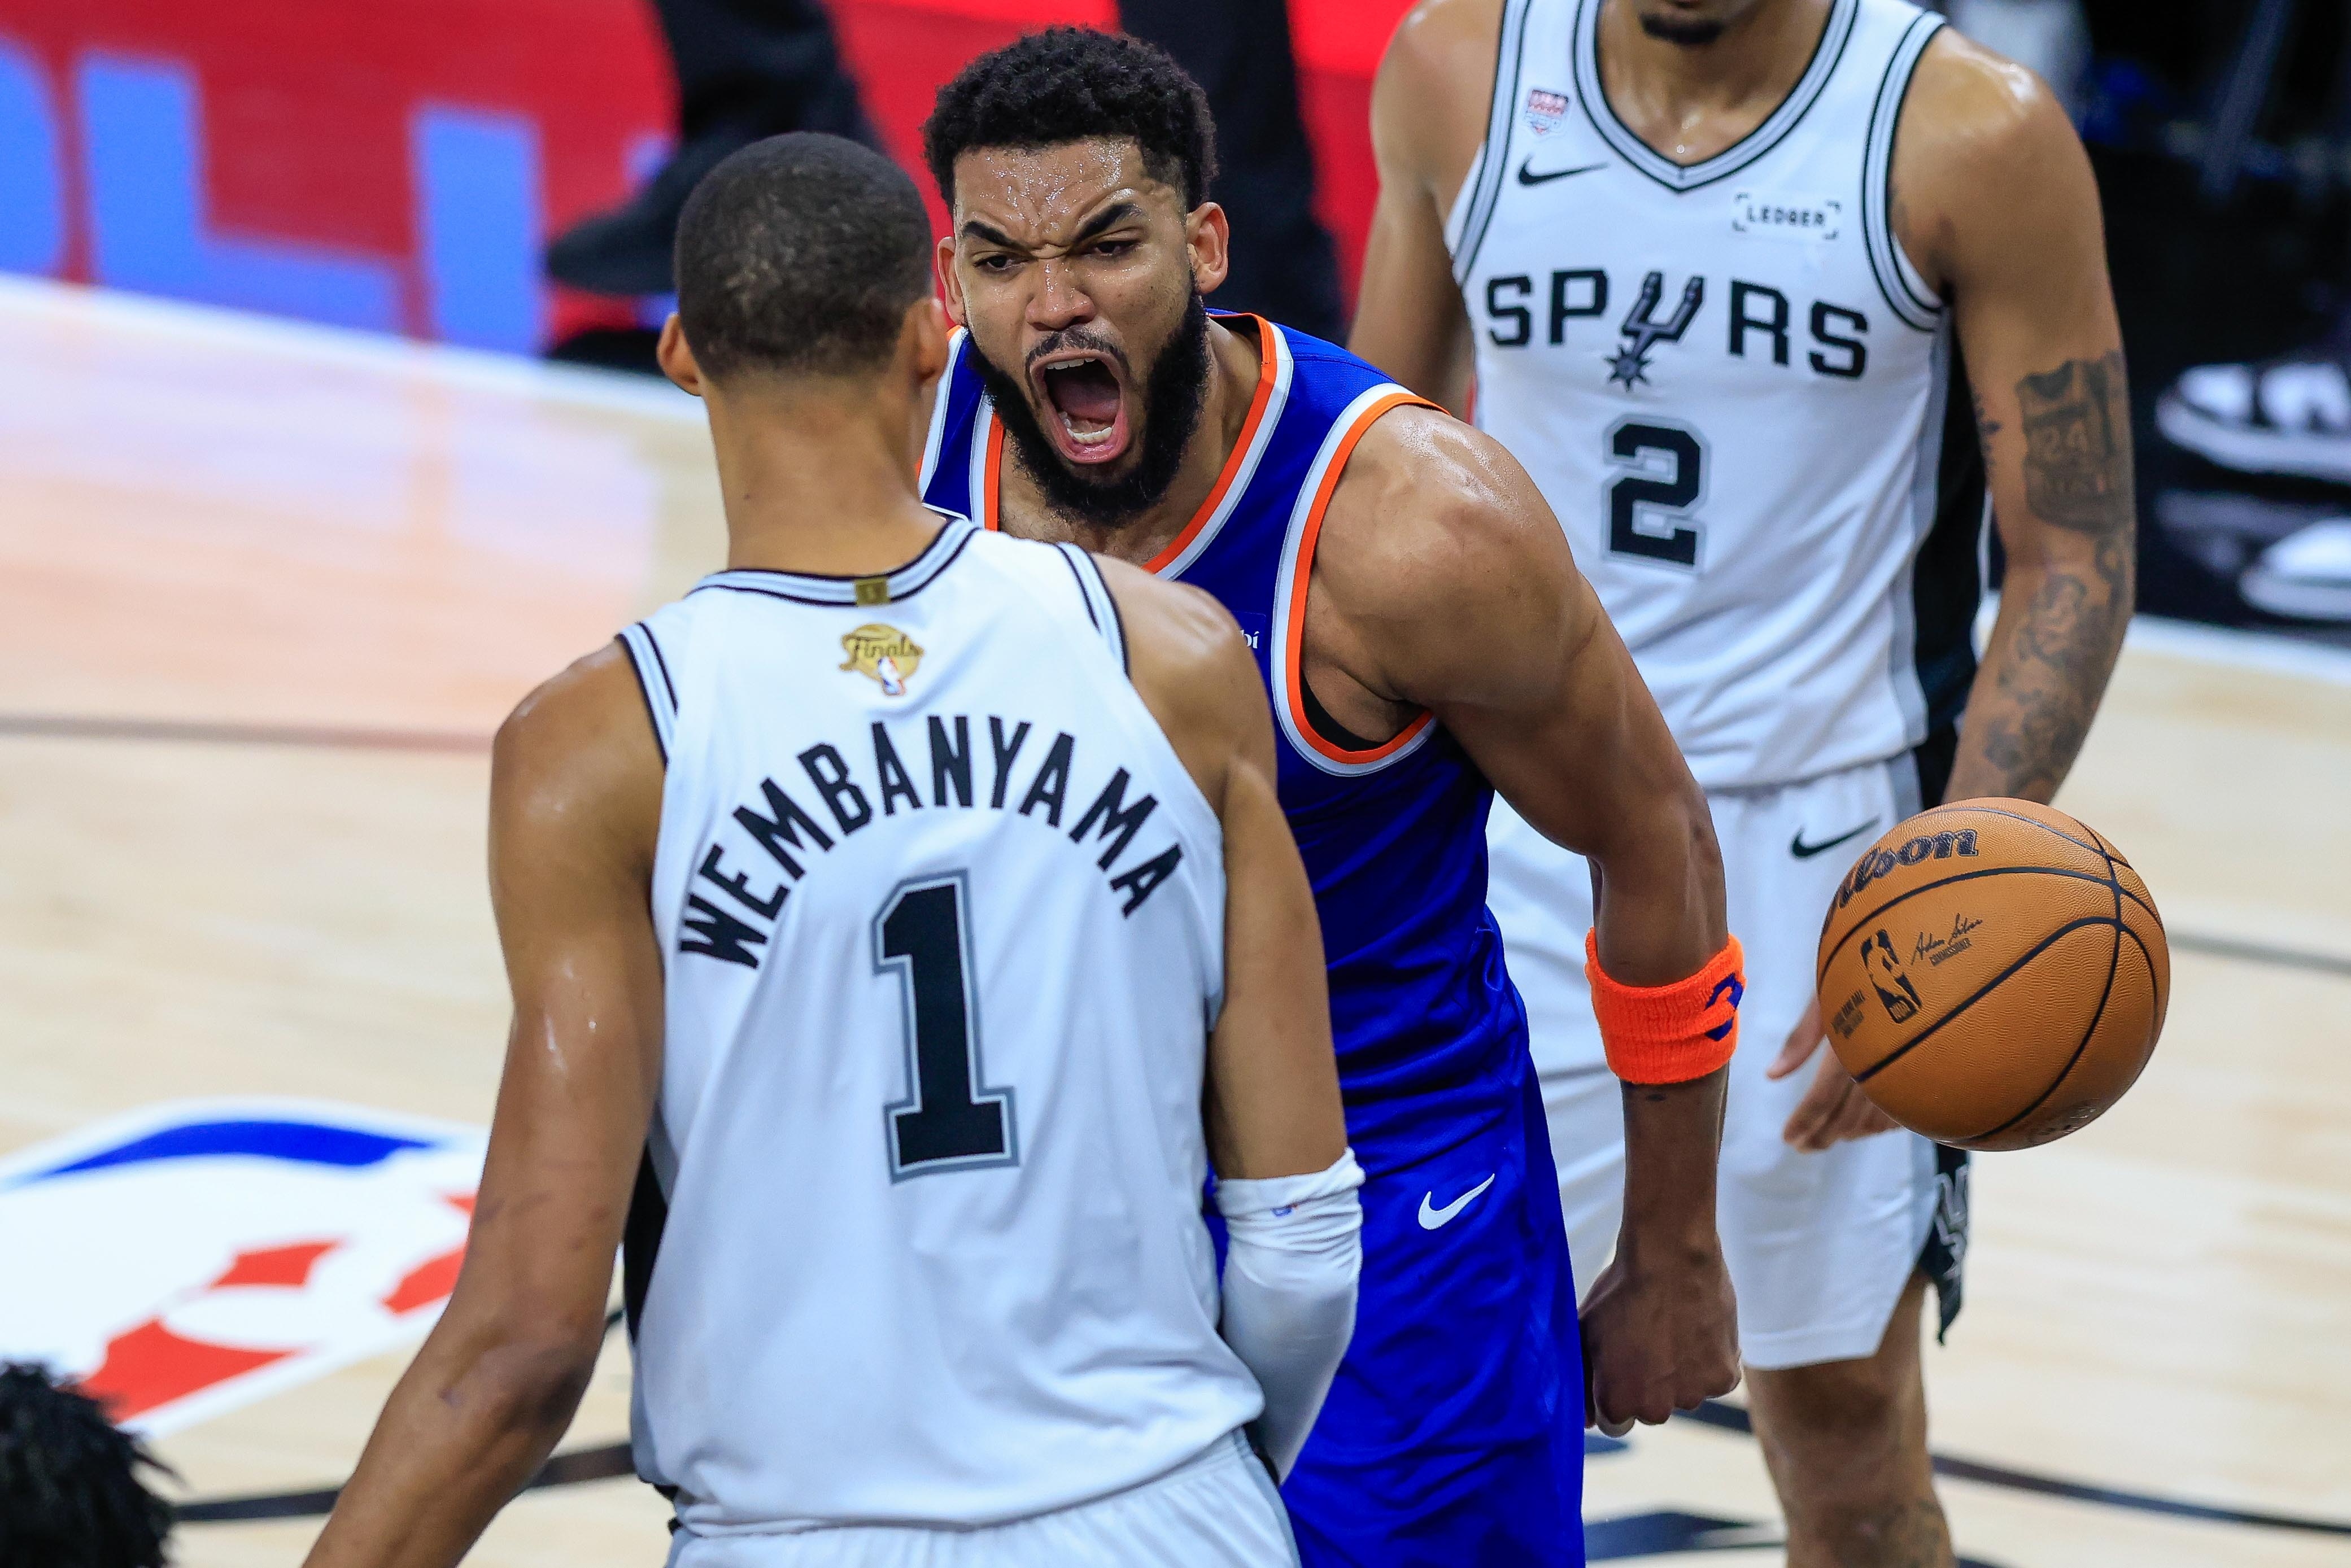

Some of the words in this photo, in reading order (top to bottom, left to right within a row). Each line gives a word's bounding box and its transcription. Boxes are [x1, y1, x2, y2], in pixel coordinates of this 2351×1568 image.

[1746, 204, 1826, 227] LEDGER
[1486, 269, 1868, 391] SPURS
[1600, 414, 1711, 572] 2
[678, 715, 1184, 969] WEMBANYAMA
[1825, 828, 1979, 926] ilson
[870, 868, 1019, 1184] 1
